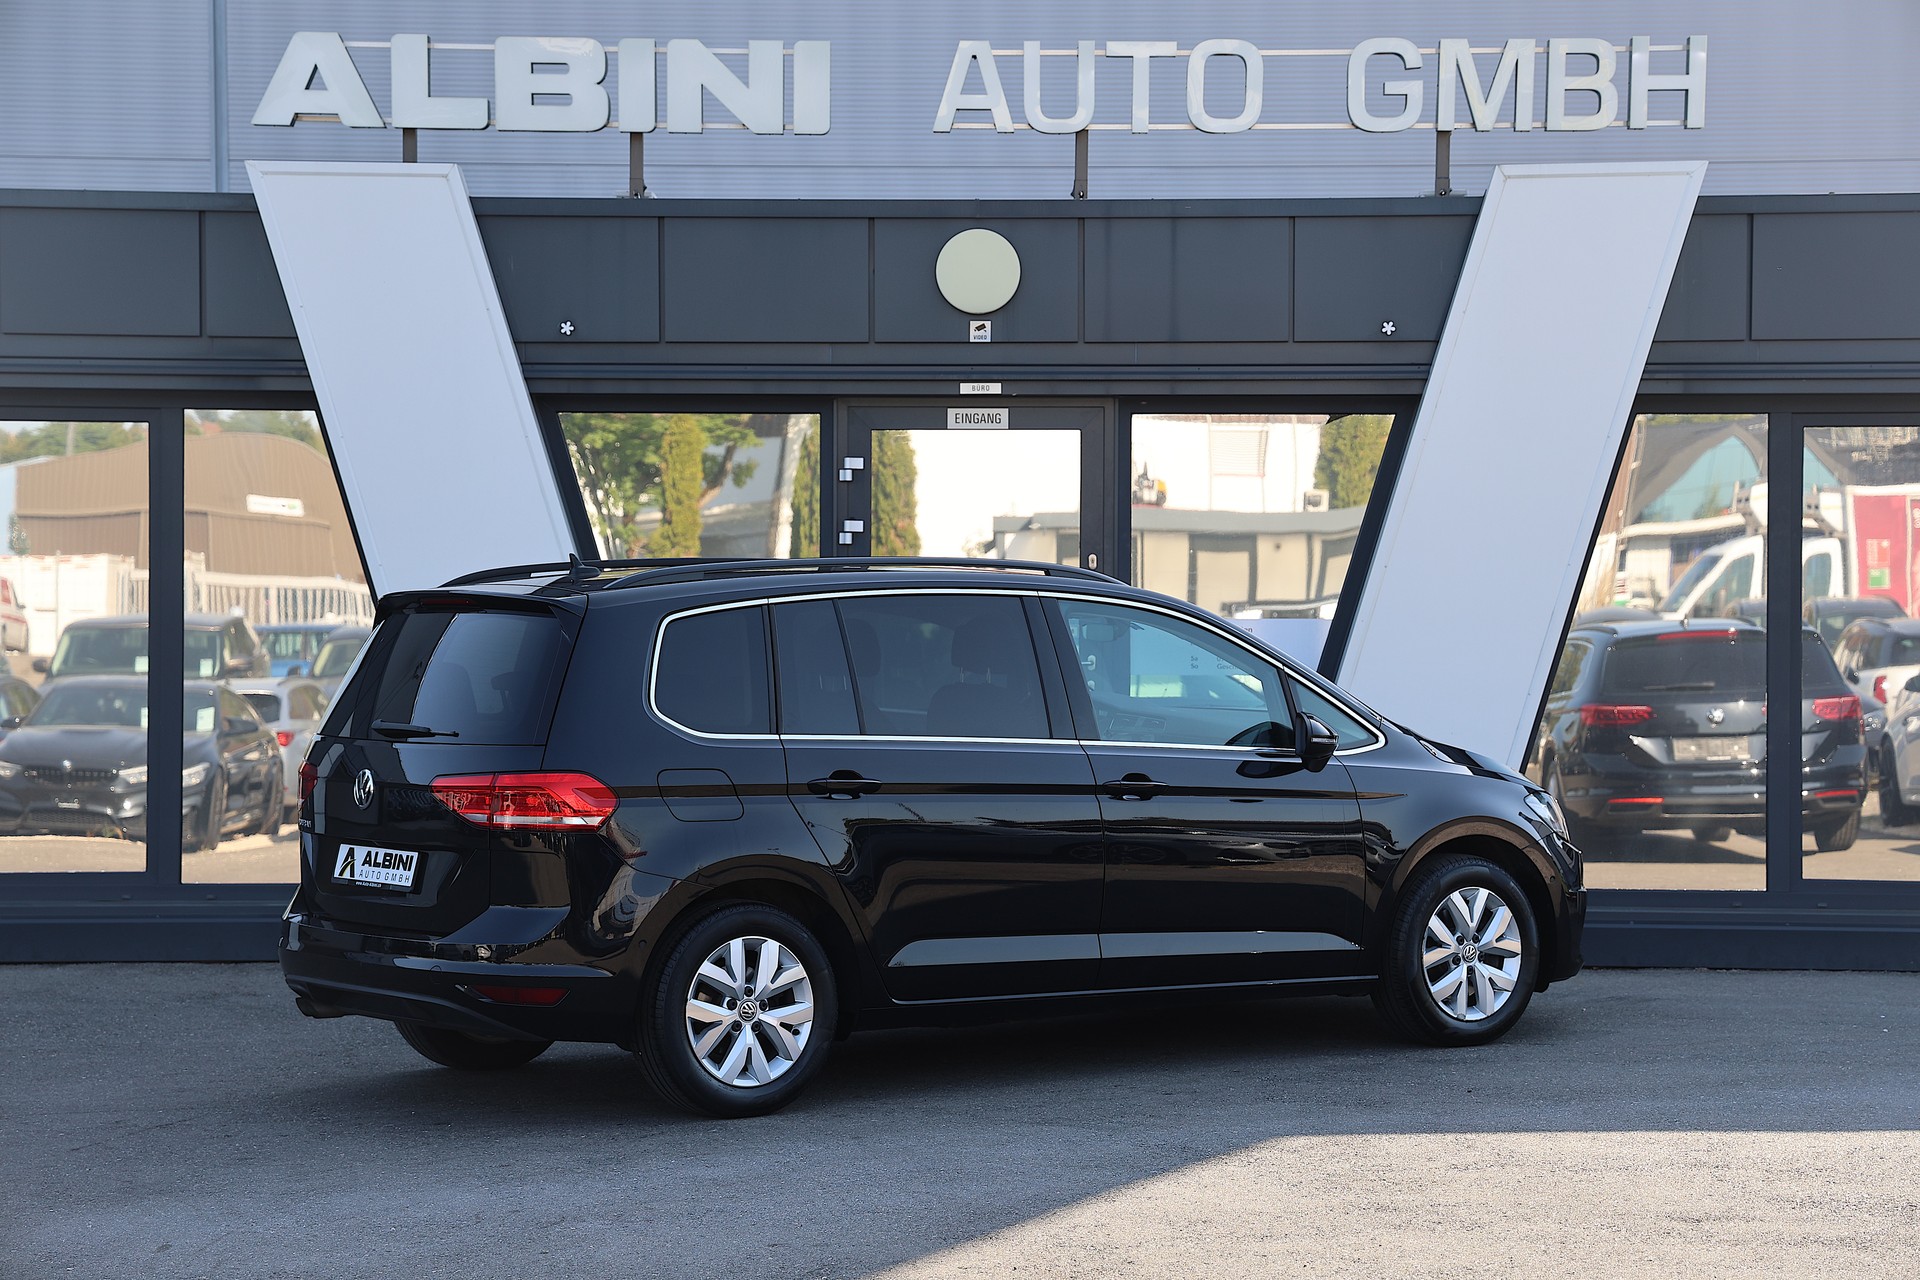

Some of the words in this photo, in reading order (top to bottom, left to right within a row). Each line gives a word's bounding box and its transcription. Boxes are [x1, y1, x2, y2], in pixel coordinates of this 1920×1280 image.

[251, 31, 831, 136] ALBINI
[932, 38, 1264, 134] AUTO
[1347, 35, 1708, 132] GMBH
[954, 412, 1002, 424] EINGANG
[361, 850, 414, 872] ALBINI
[358, 869, 381, 880] AUTO
[384, 872, 411, 883] GMBH
